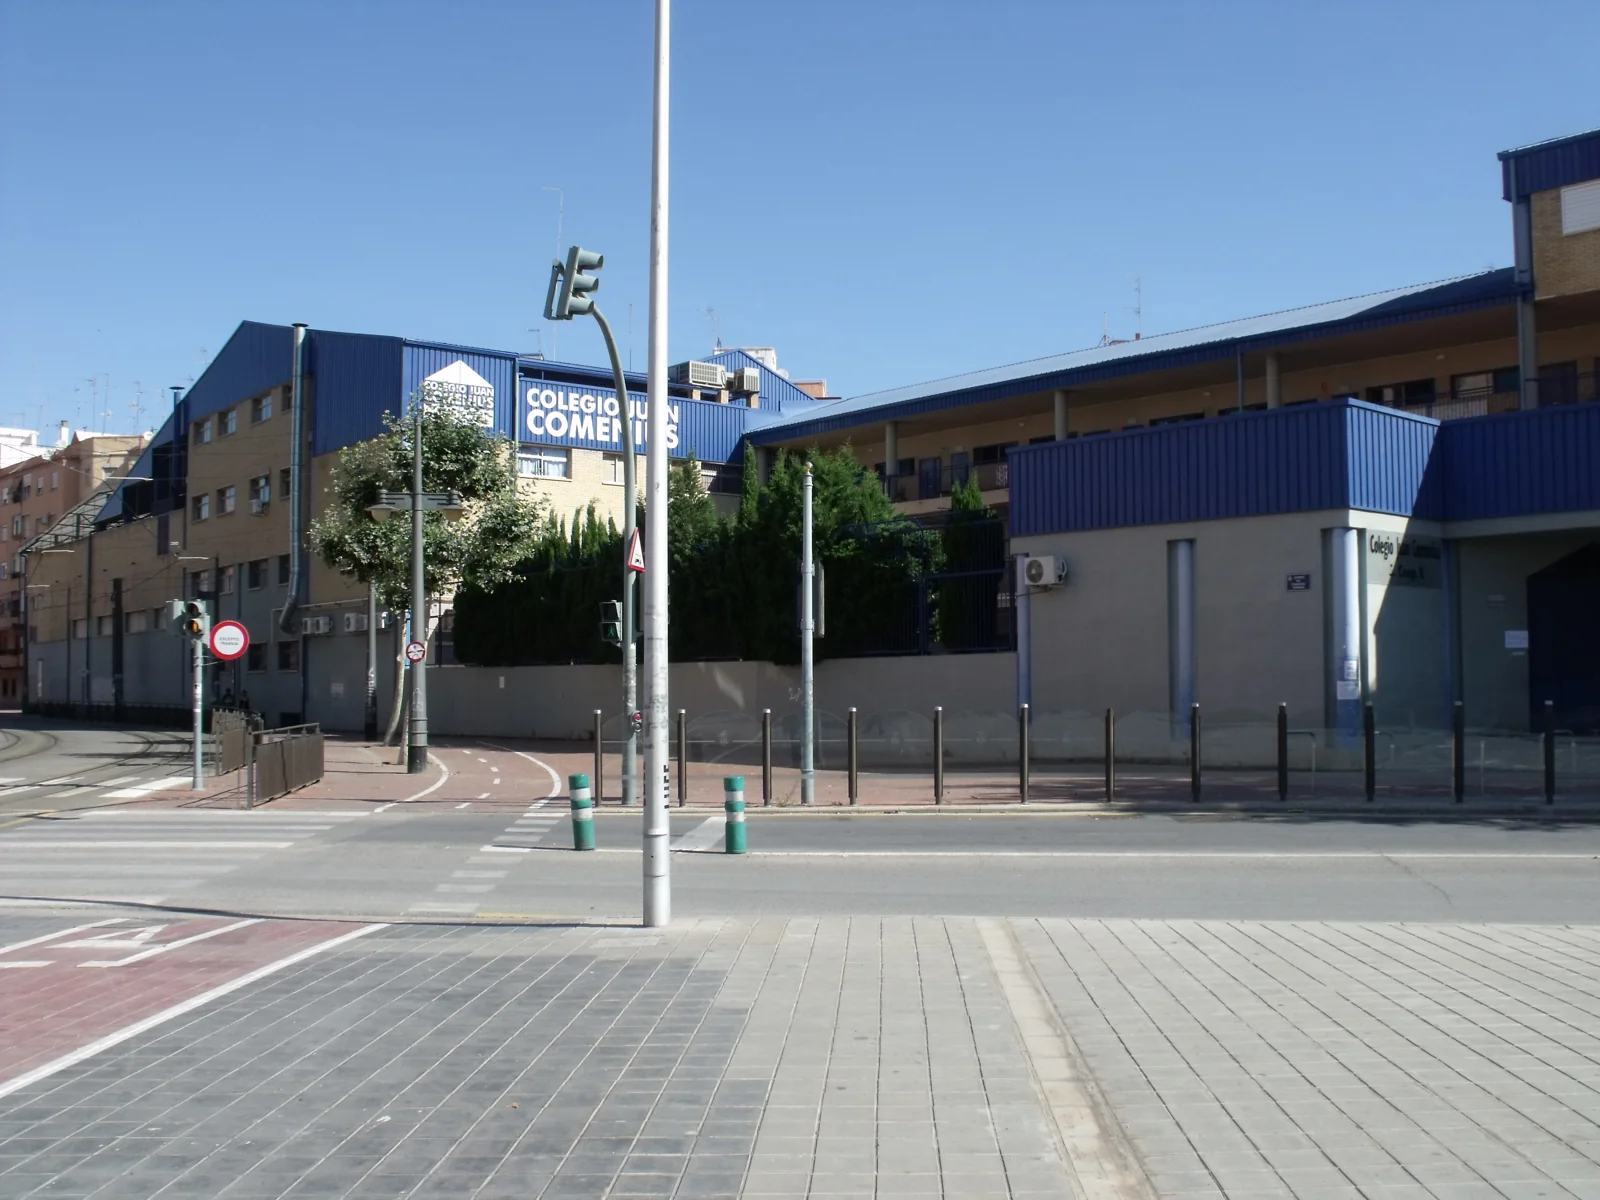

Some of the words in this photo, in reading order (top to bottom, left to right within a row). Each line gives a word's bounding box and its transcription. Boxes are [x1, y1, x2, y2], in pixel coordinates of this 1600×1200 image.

[527, 388, 620, 417] COLEGIO
[628, 400, 679, 423] JUN
[527, 409, 679, 449] COMENIS
[1370, 534, 1394, 560] Colegio
